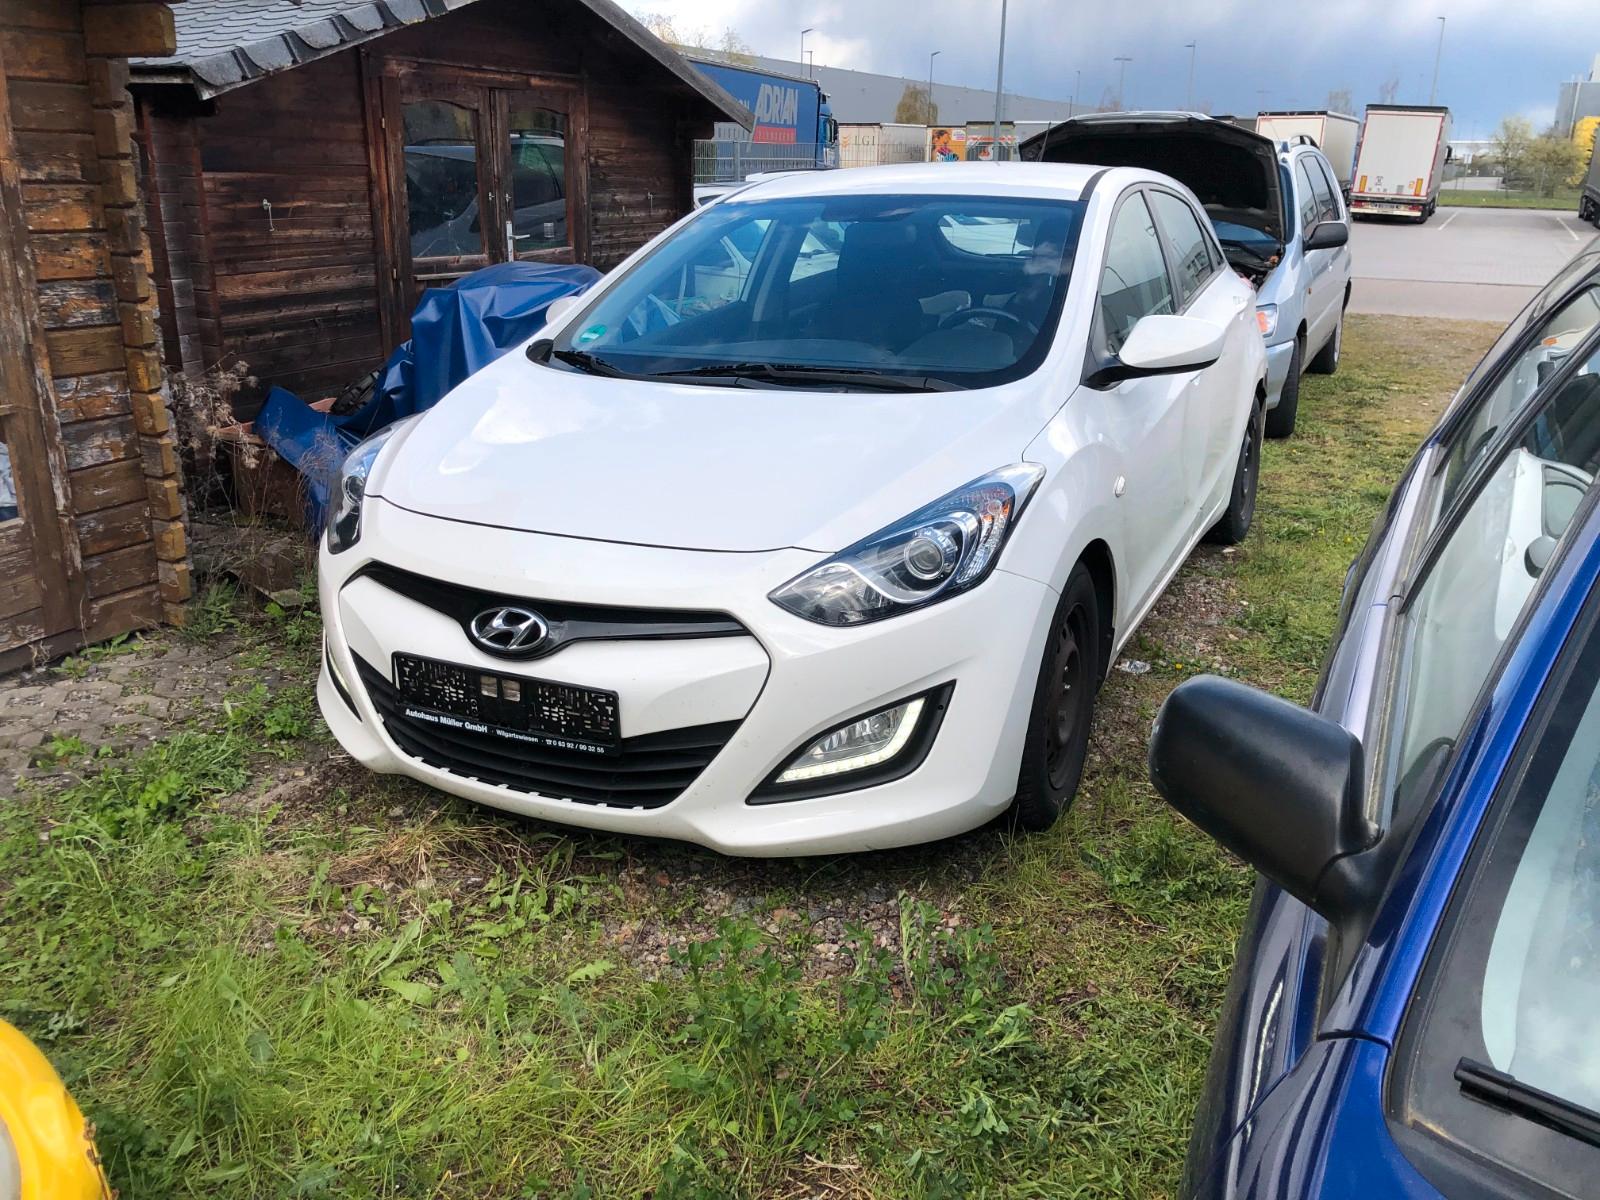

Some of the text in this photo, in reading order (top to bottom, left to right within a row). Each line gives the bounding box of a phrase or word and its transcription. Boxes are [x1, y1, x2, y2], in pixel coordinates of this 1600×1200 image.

[755, 83, 798, 125] ADRIAN
[405, 708, 439, 723] Autohaus
[440, 716, 463, 728] Müller
[464, 721, 488, 733] GmbH
